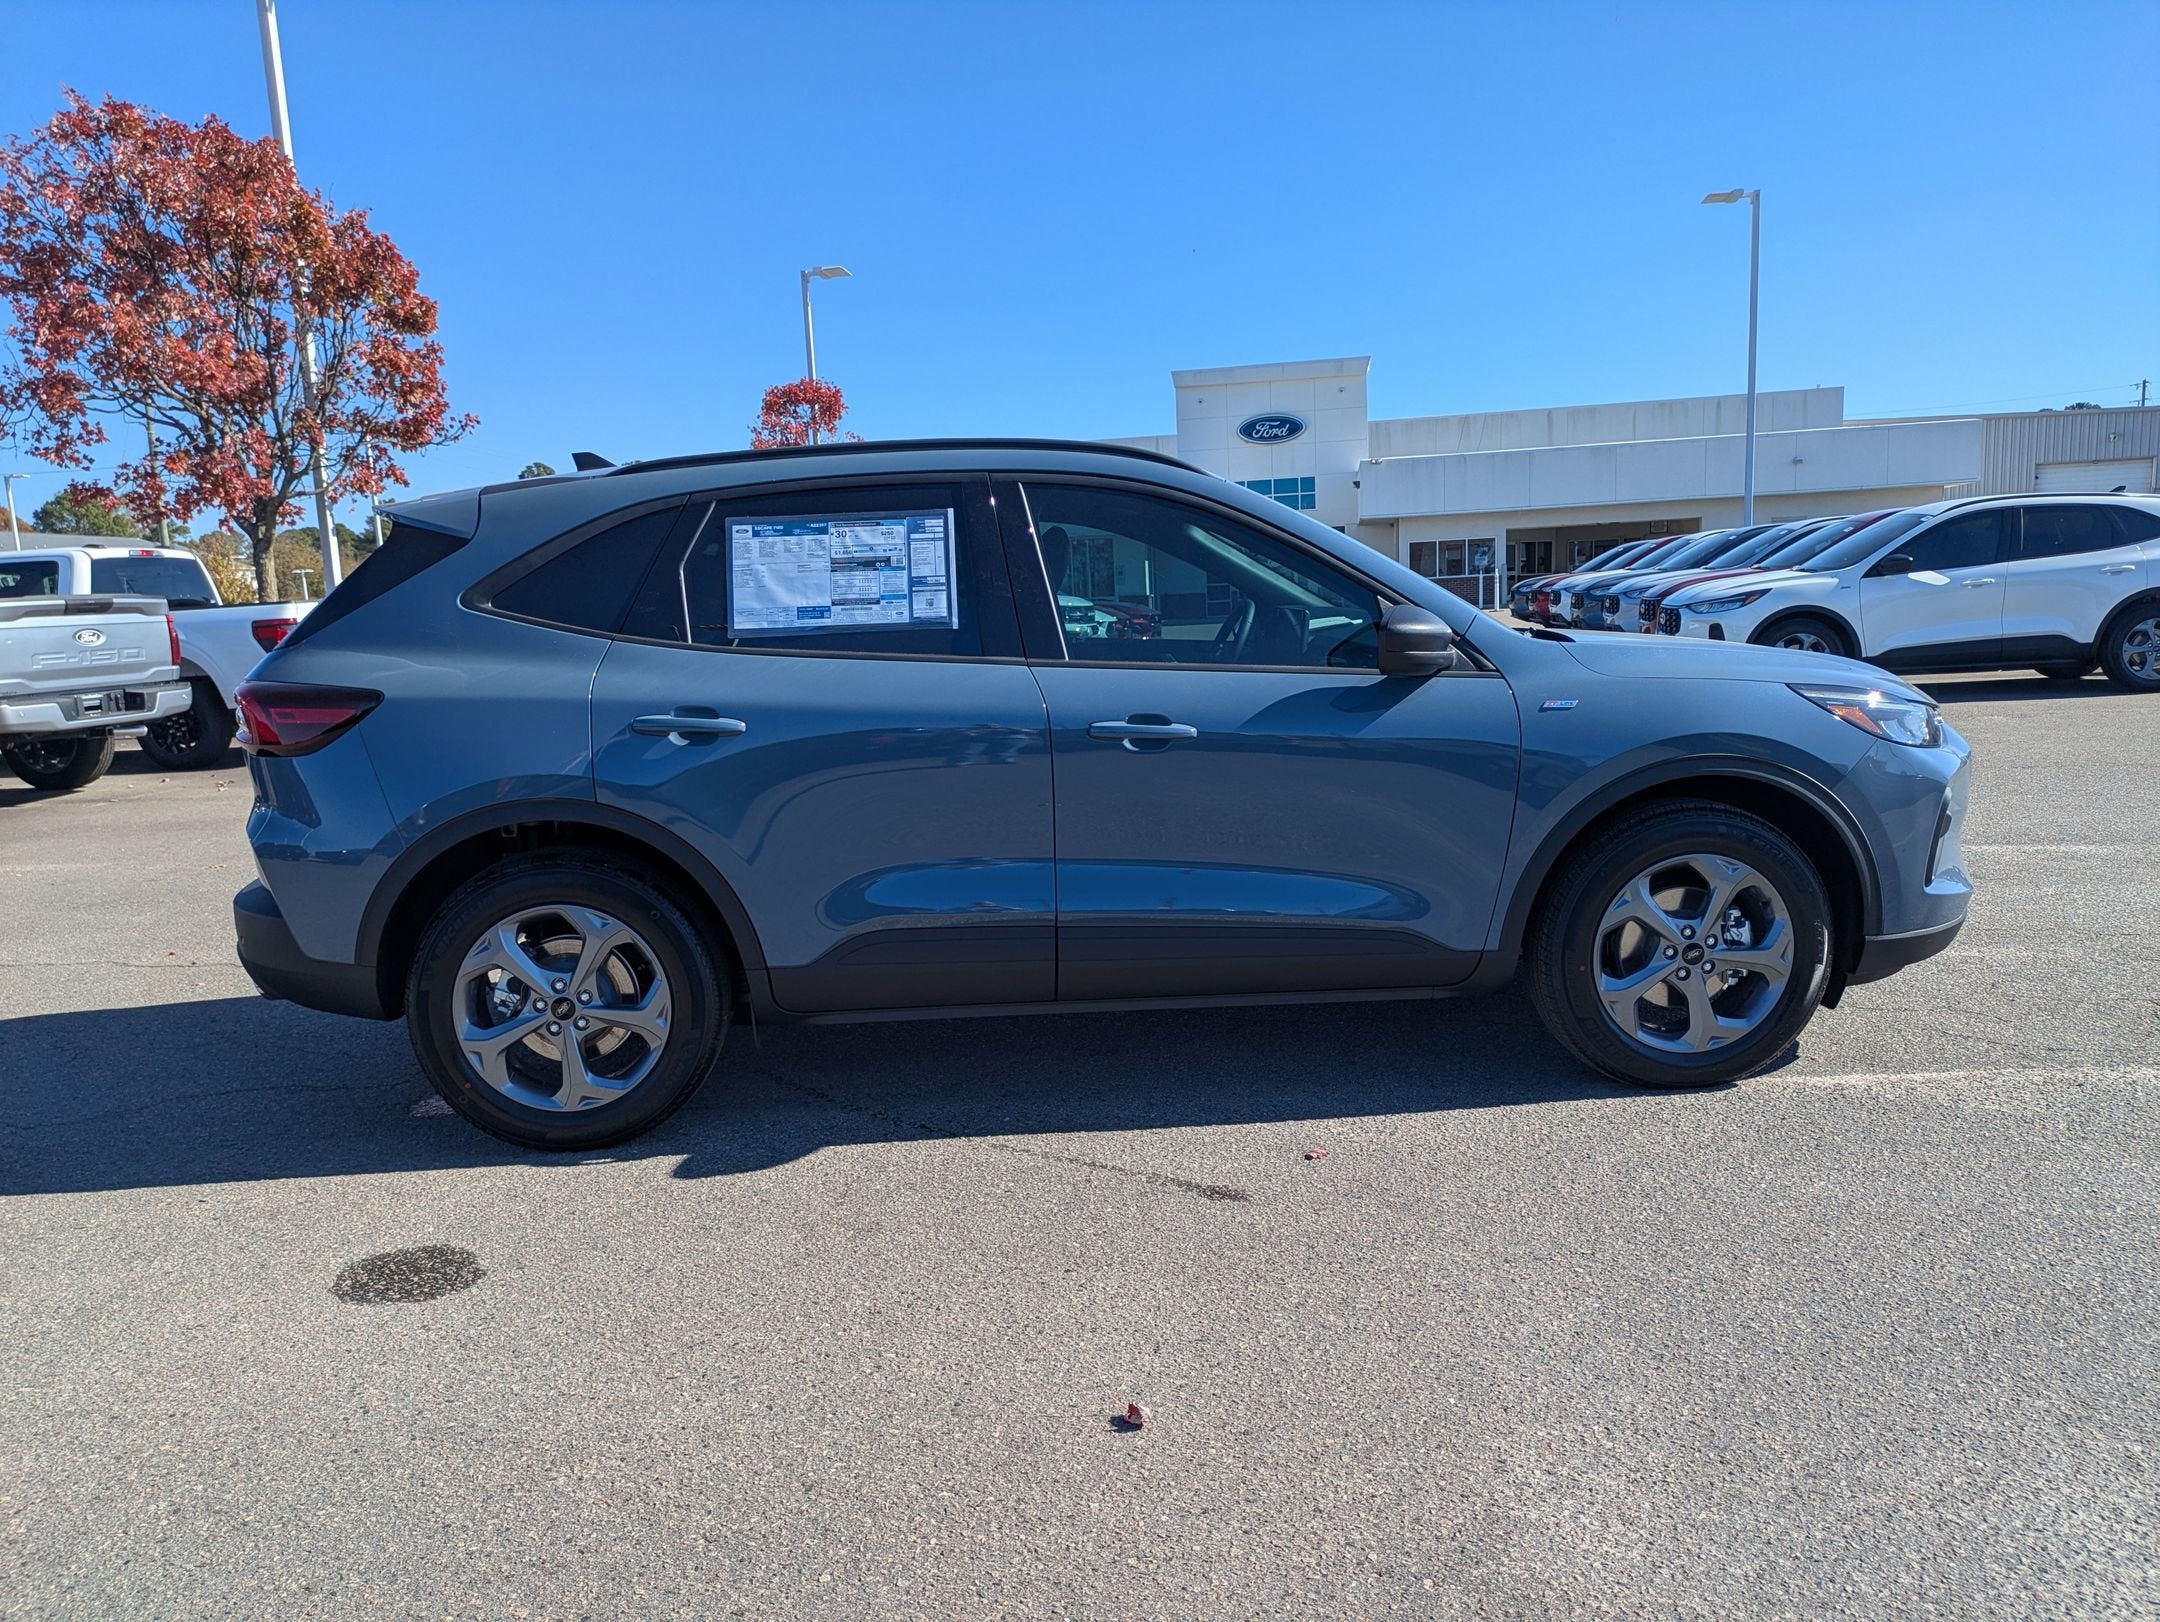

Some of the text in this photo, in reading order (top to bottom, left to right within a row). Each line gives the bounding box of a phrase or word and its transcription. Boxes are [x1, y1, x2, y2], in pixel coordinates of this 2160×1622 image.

[1252, 421, 1290, 438] Ford
[835, 530, 847, 538] 30
[31, 646, 146, 669] F-150
